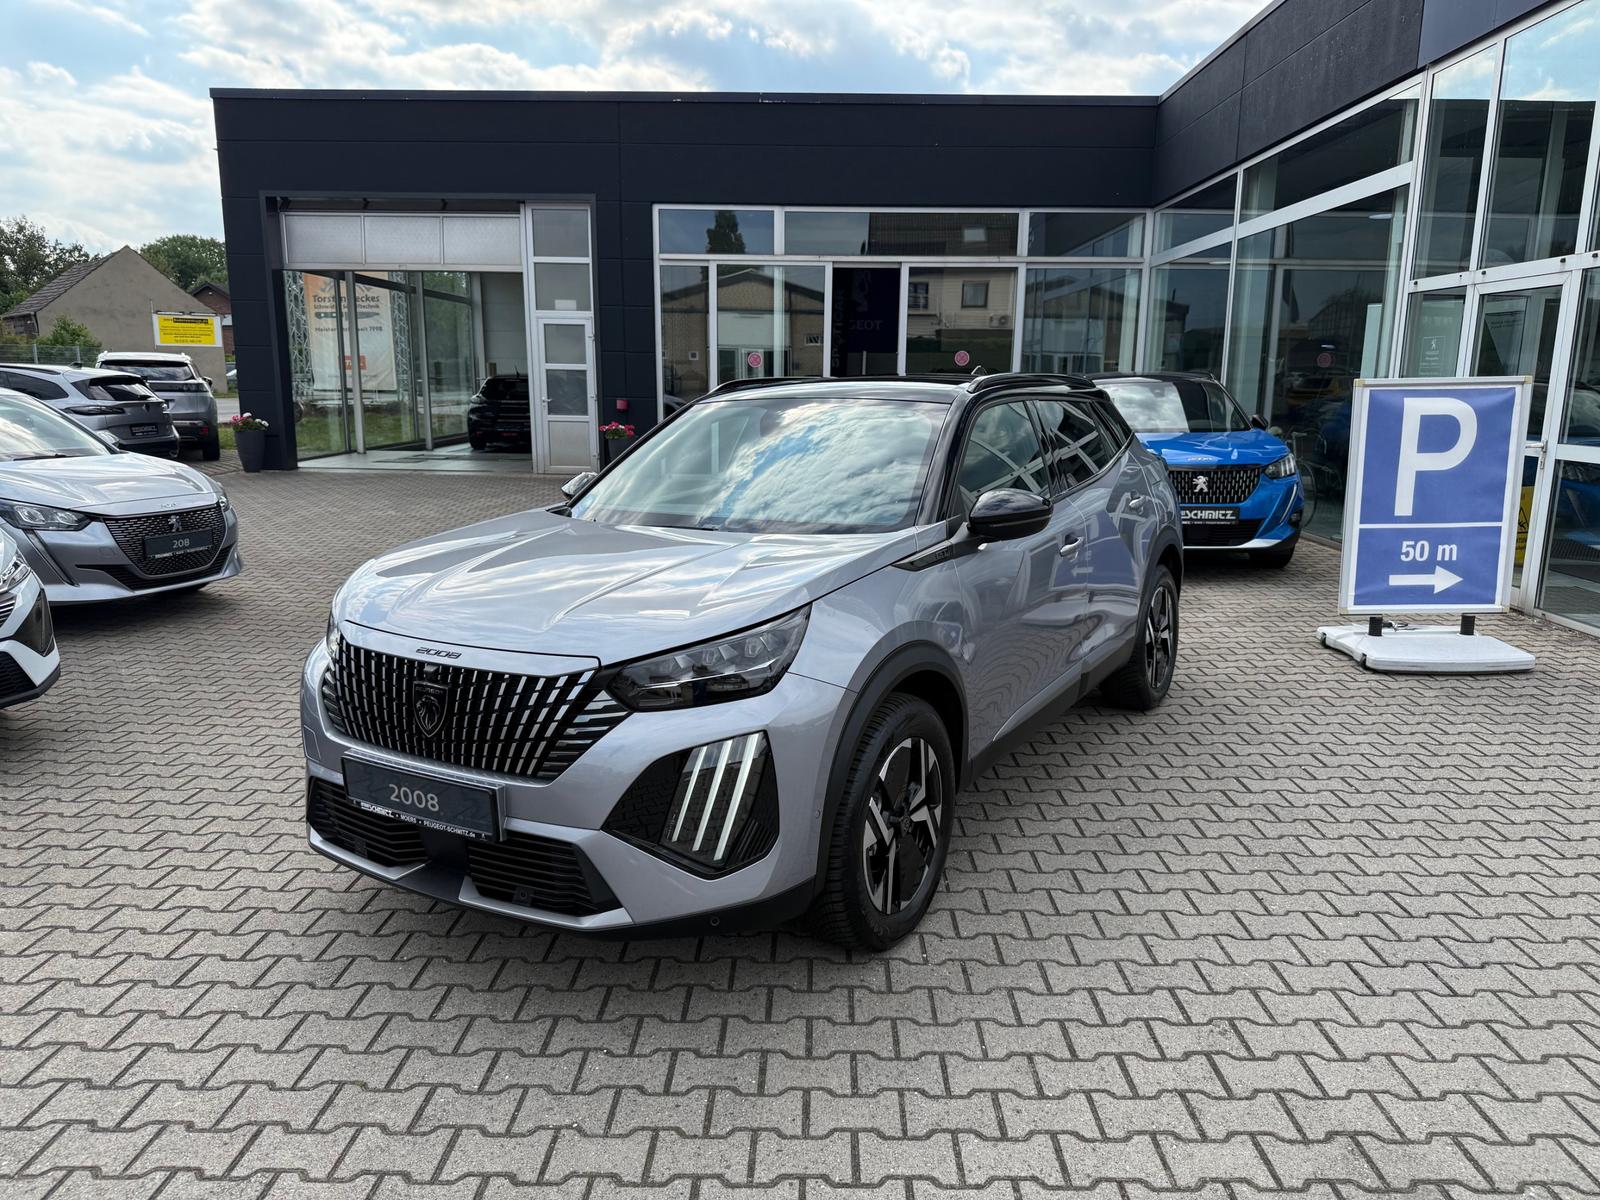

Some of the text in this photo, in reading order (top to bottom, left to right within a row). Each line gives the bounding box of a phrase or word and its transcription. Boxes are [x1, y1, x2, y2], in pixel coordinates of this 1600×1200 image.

[313, 294, 380, 303] Torstn eckes
[1394, 397, 1478, 516] P
[172, 538, 190, 549] 208
[1400, 540, 1458, 562] 50 m
[415, 646, 462, 660] 2008
[388, 783, 440, 812] 2008
